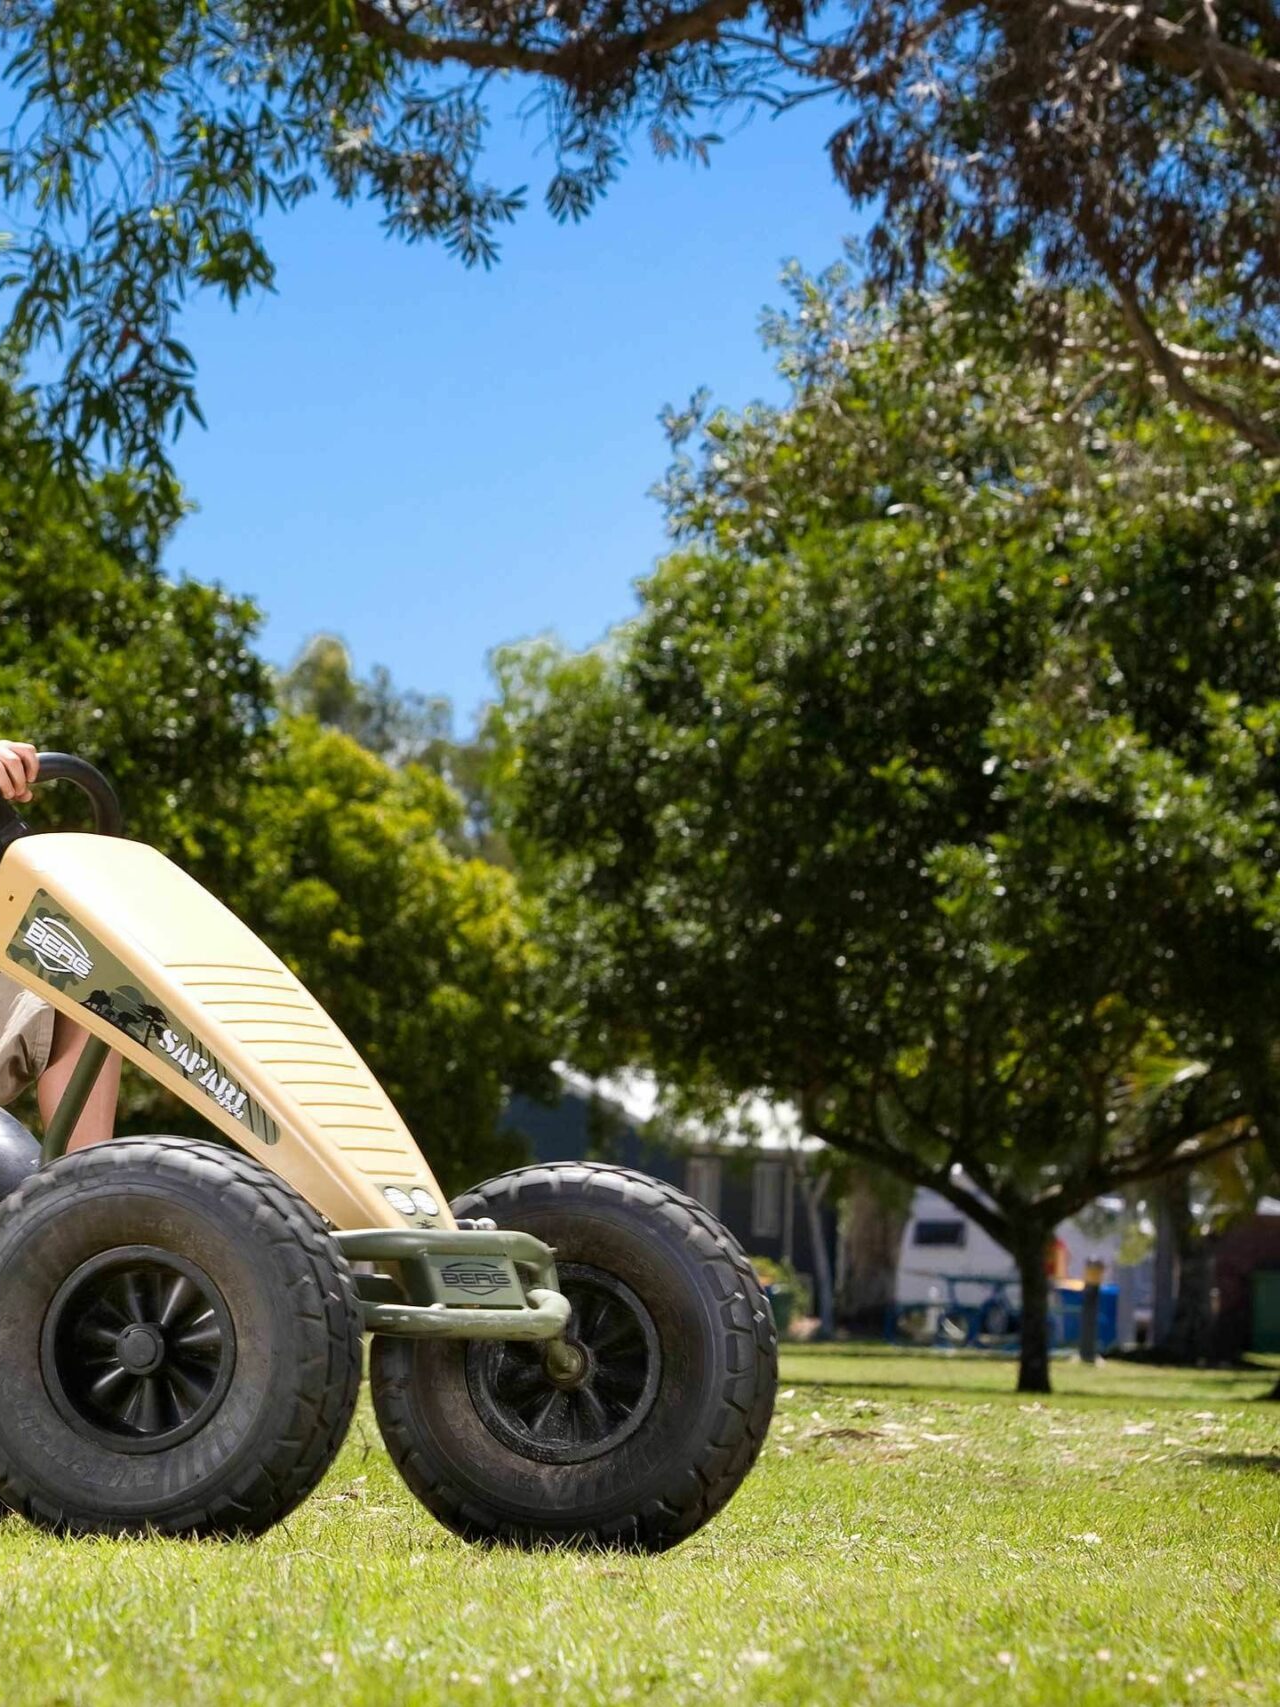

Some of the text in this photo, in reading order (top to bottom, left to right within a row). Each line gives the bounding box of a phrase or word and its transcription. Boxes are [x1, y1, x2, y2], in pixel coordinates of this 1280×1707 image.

[25, 922, 92, 975] BERG
[158, 1029, 247, 1108] SAFARI
[441, 1272, 511, 1285] BERG
